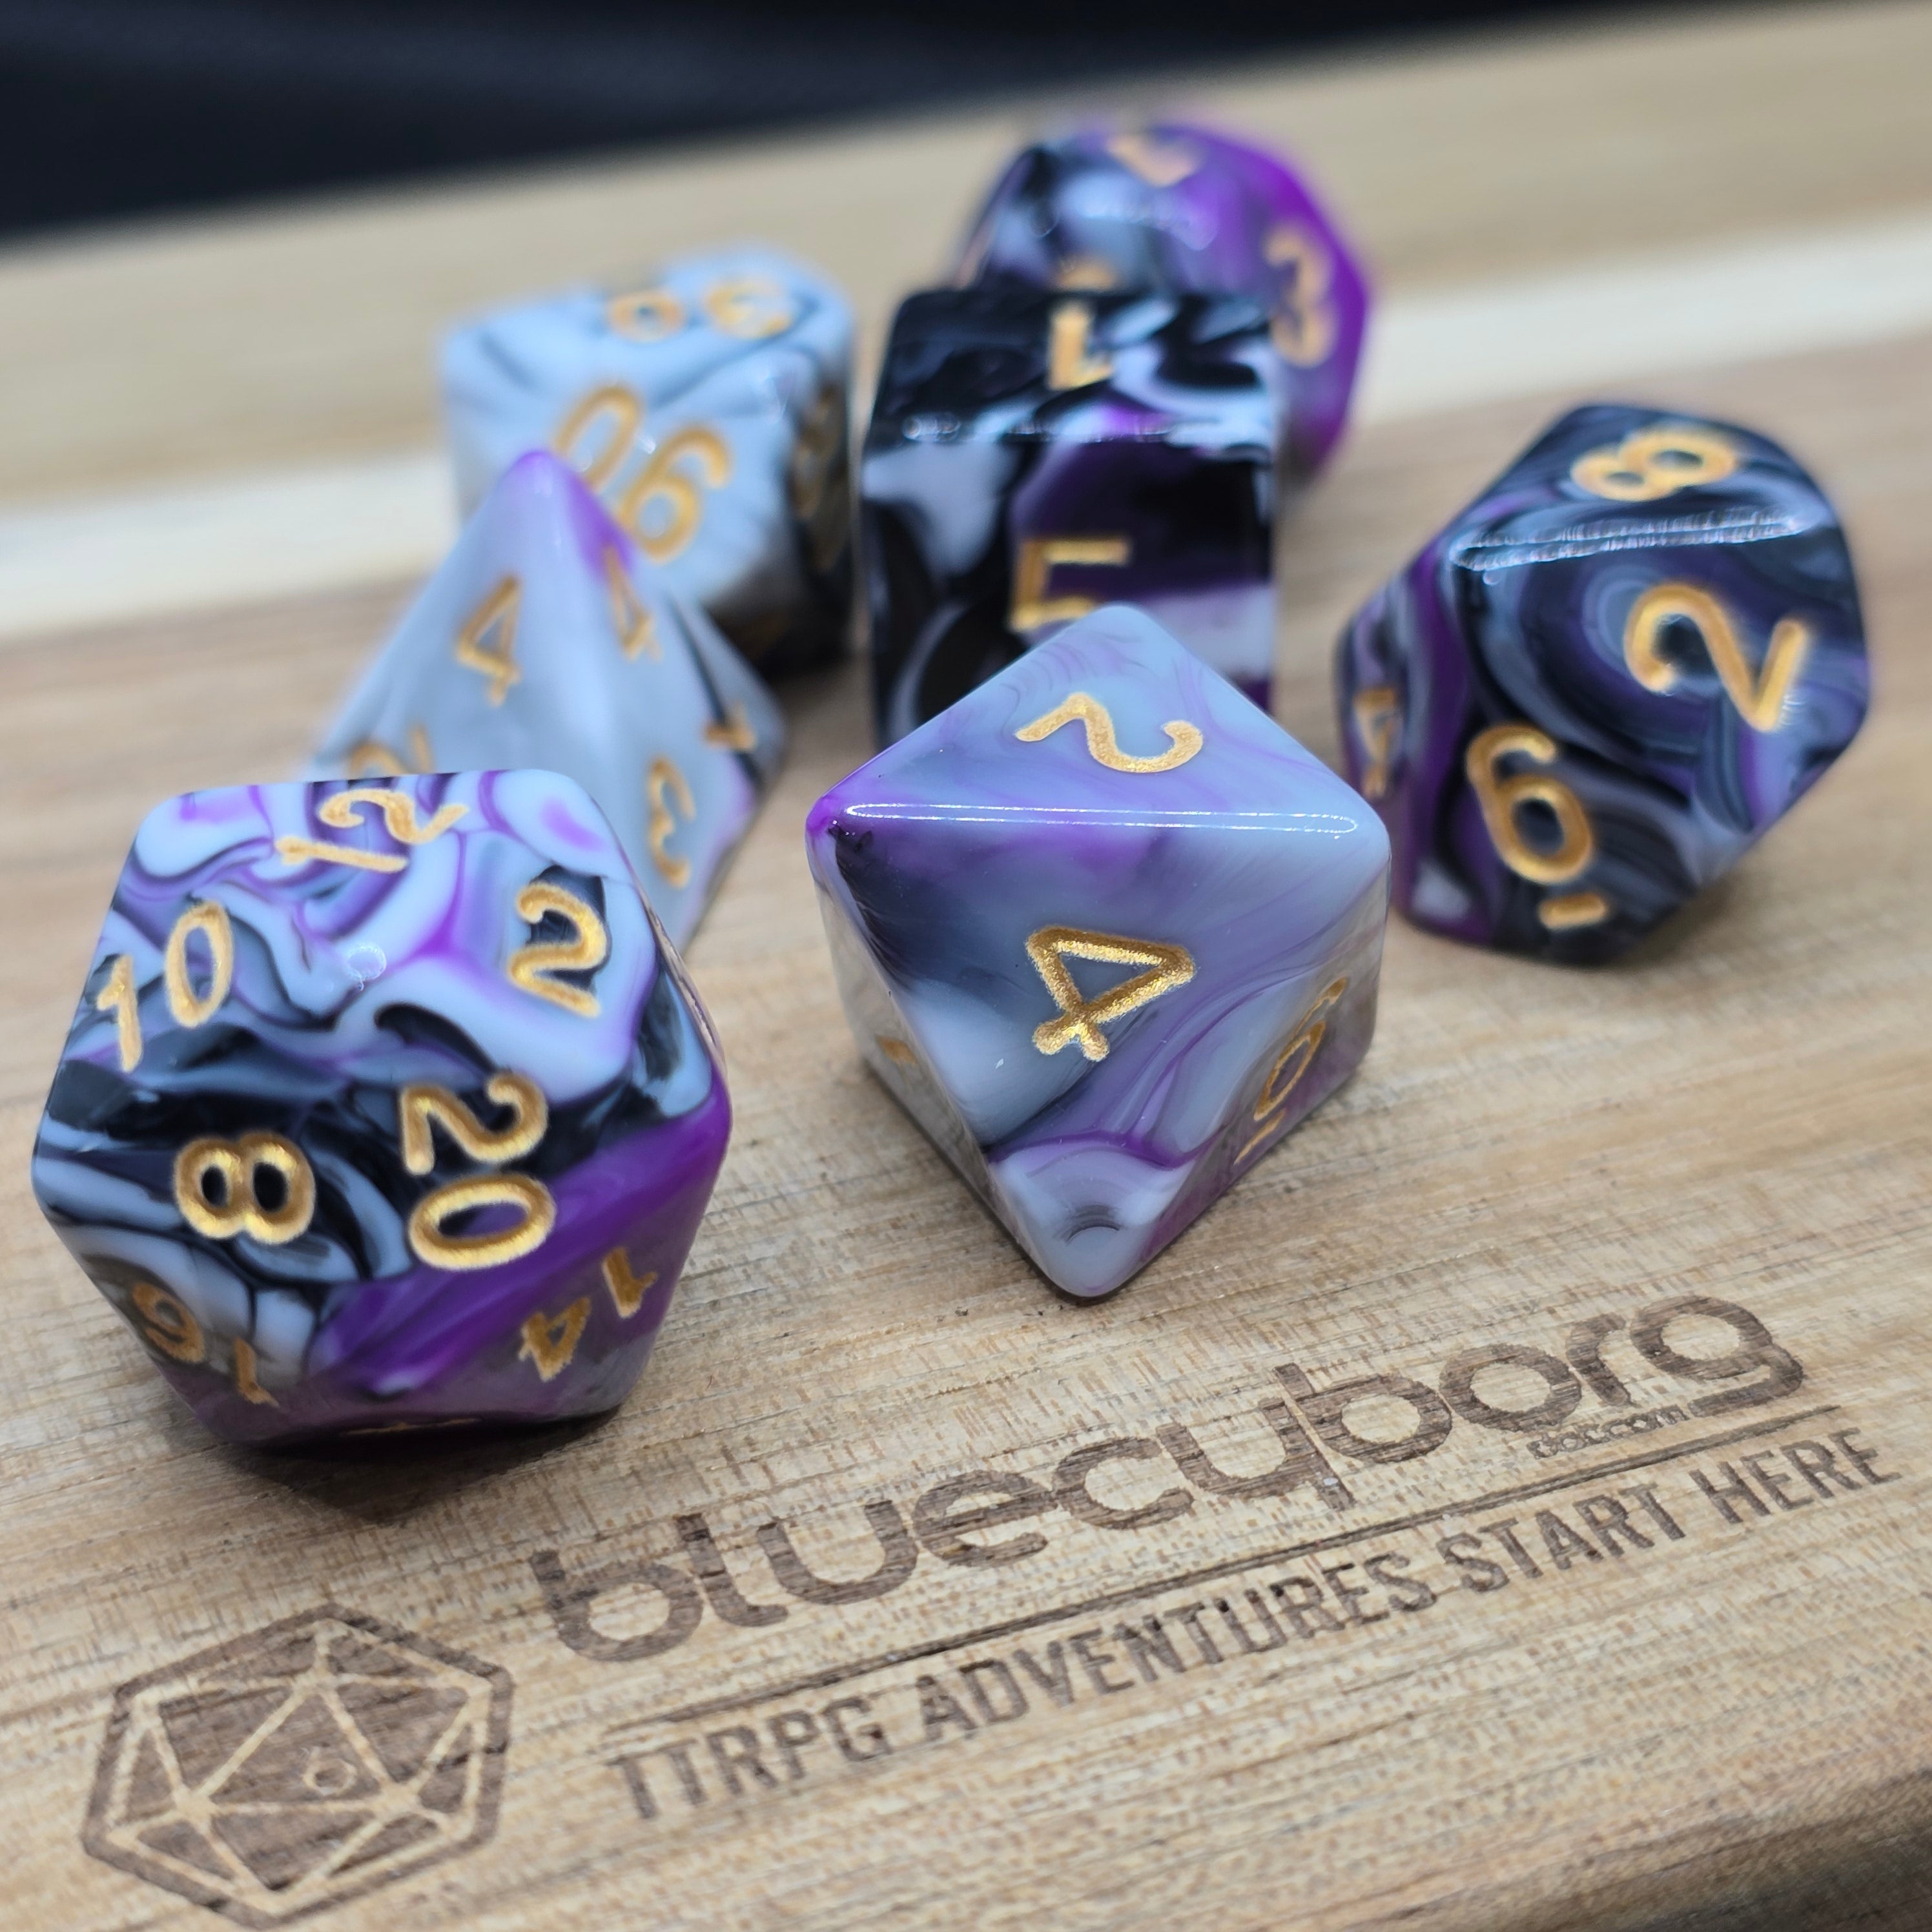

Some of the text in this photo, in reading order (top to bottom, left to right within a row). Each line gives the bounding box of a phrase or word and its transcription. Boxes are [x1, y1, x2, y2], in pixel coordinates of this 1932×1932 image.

[1570, 426, 1738, 502] 8
[456, 572, 523, 708] 4
[1624, 580, 1807, 734] 2
[1014, 692, 1204, 774] 2
[275, 788, 469, 874] 12
[97, 903, 234, 1073] 10
[507, 883, 607, 1018] 2
[1025, 925, 1196, 1063] 4
[174, 1132, 316, 1245] 8
[398, 1073, 557, 1271] 20
[520, 1246, 657, 1382] 14
[528, 1294, 1805, 1663] bluecyborg
[607, 1427, 1902, 1820] TTRPG ADVENTURES START HERE
